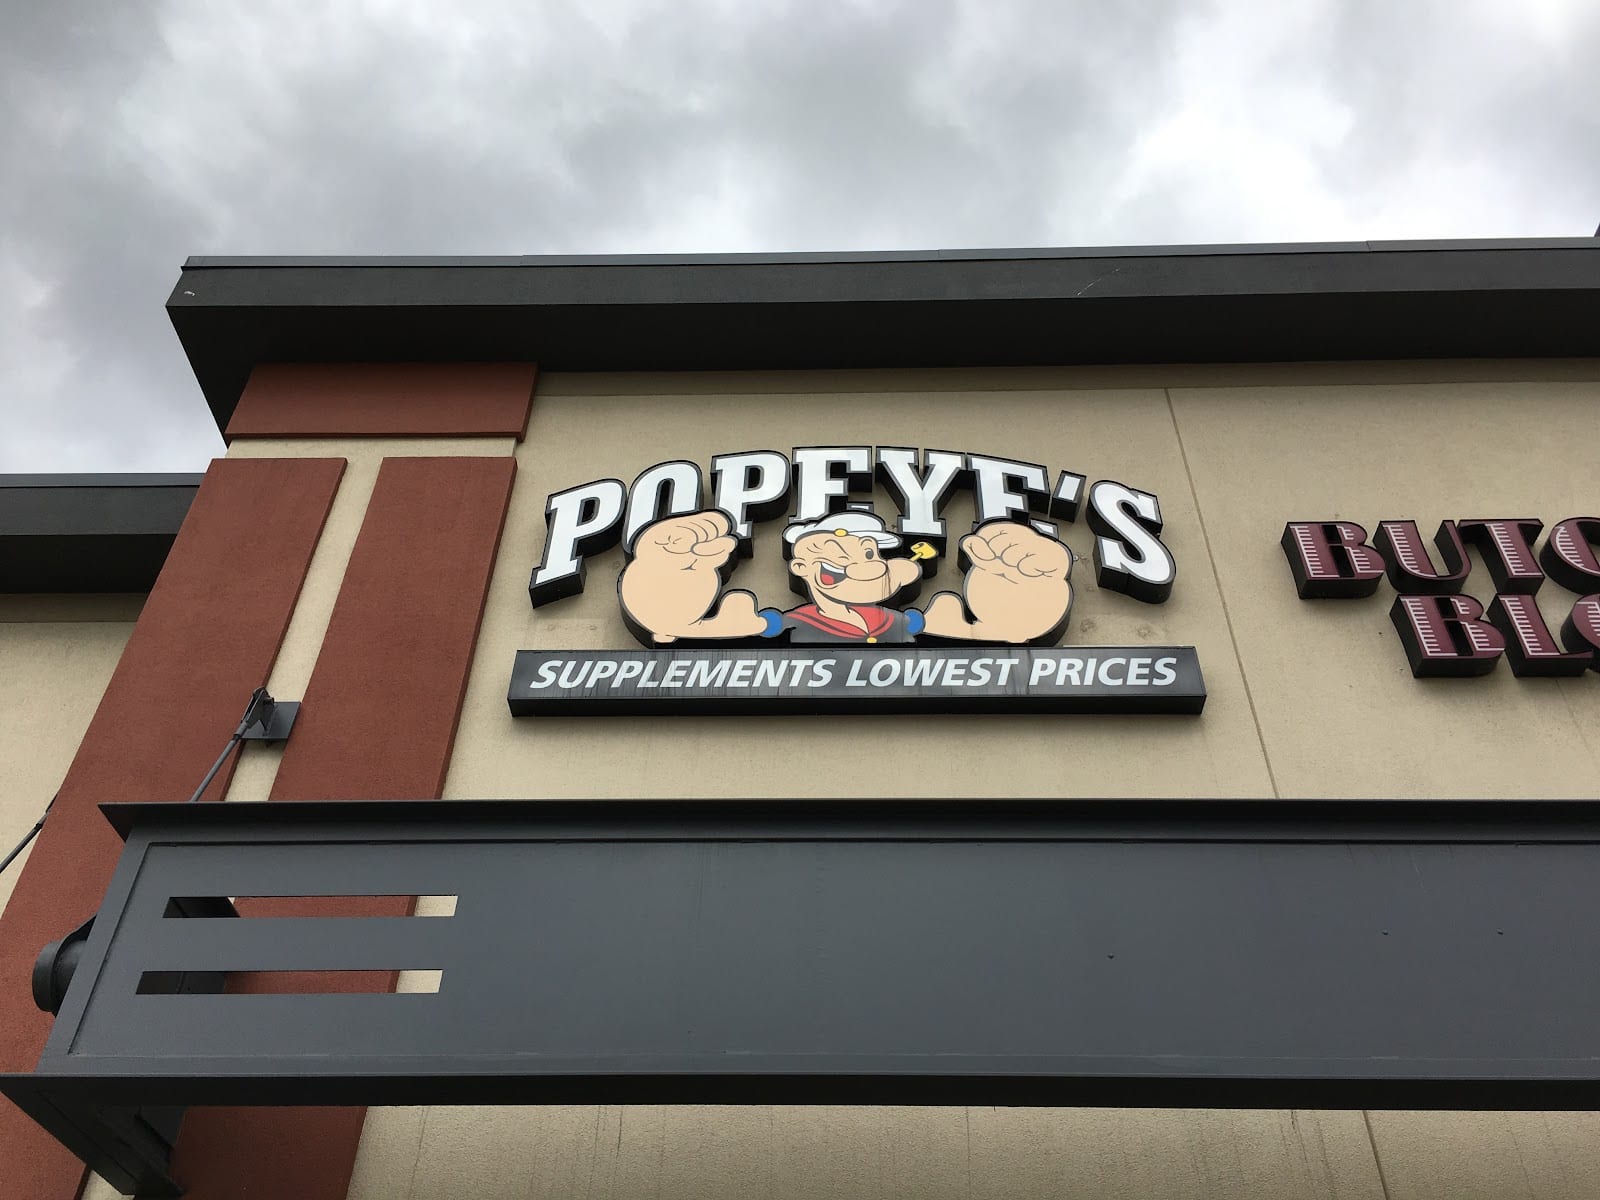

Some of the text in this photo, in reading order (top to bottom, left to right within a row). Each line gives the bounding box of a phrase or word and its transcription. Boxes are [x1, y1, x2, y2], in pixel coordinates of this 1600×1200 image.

[530, 446, 1177, 598] POPEYE'S
[529, 657, 1177, 690] SUPPLEMENTS LOWEST PRICES
